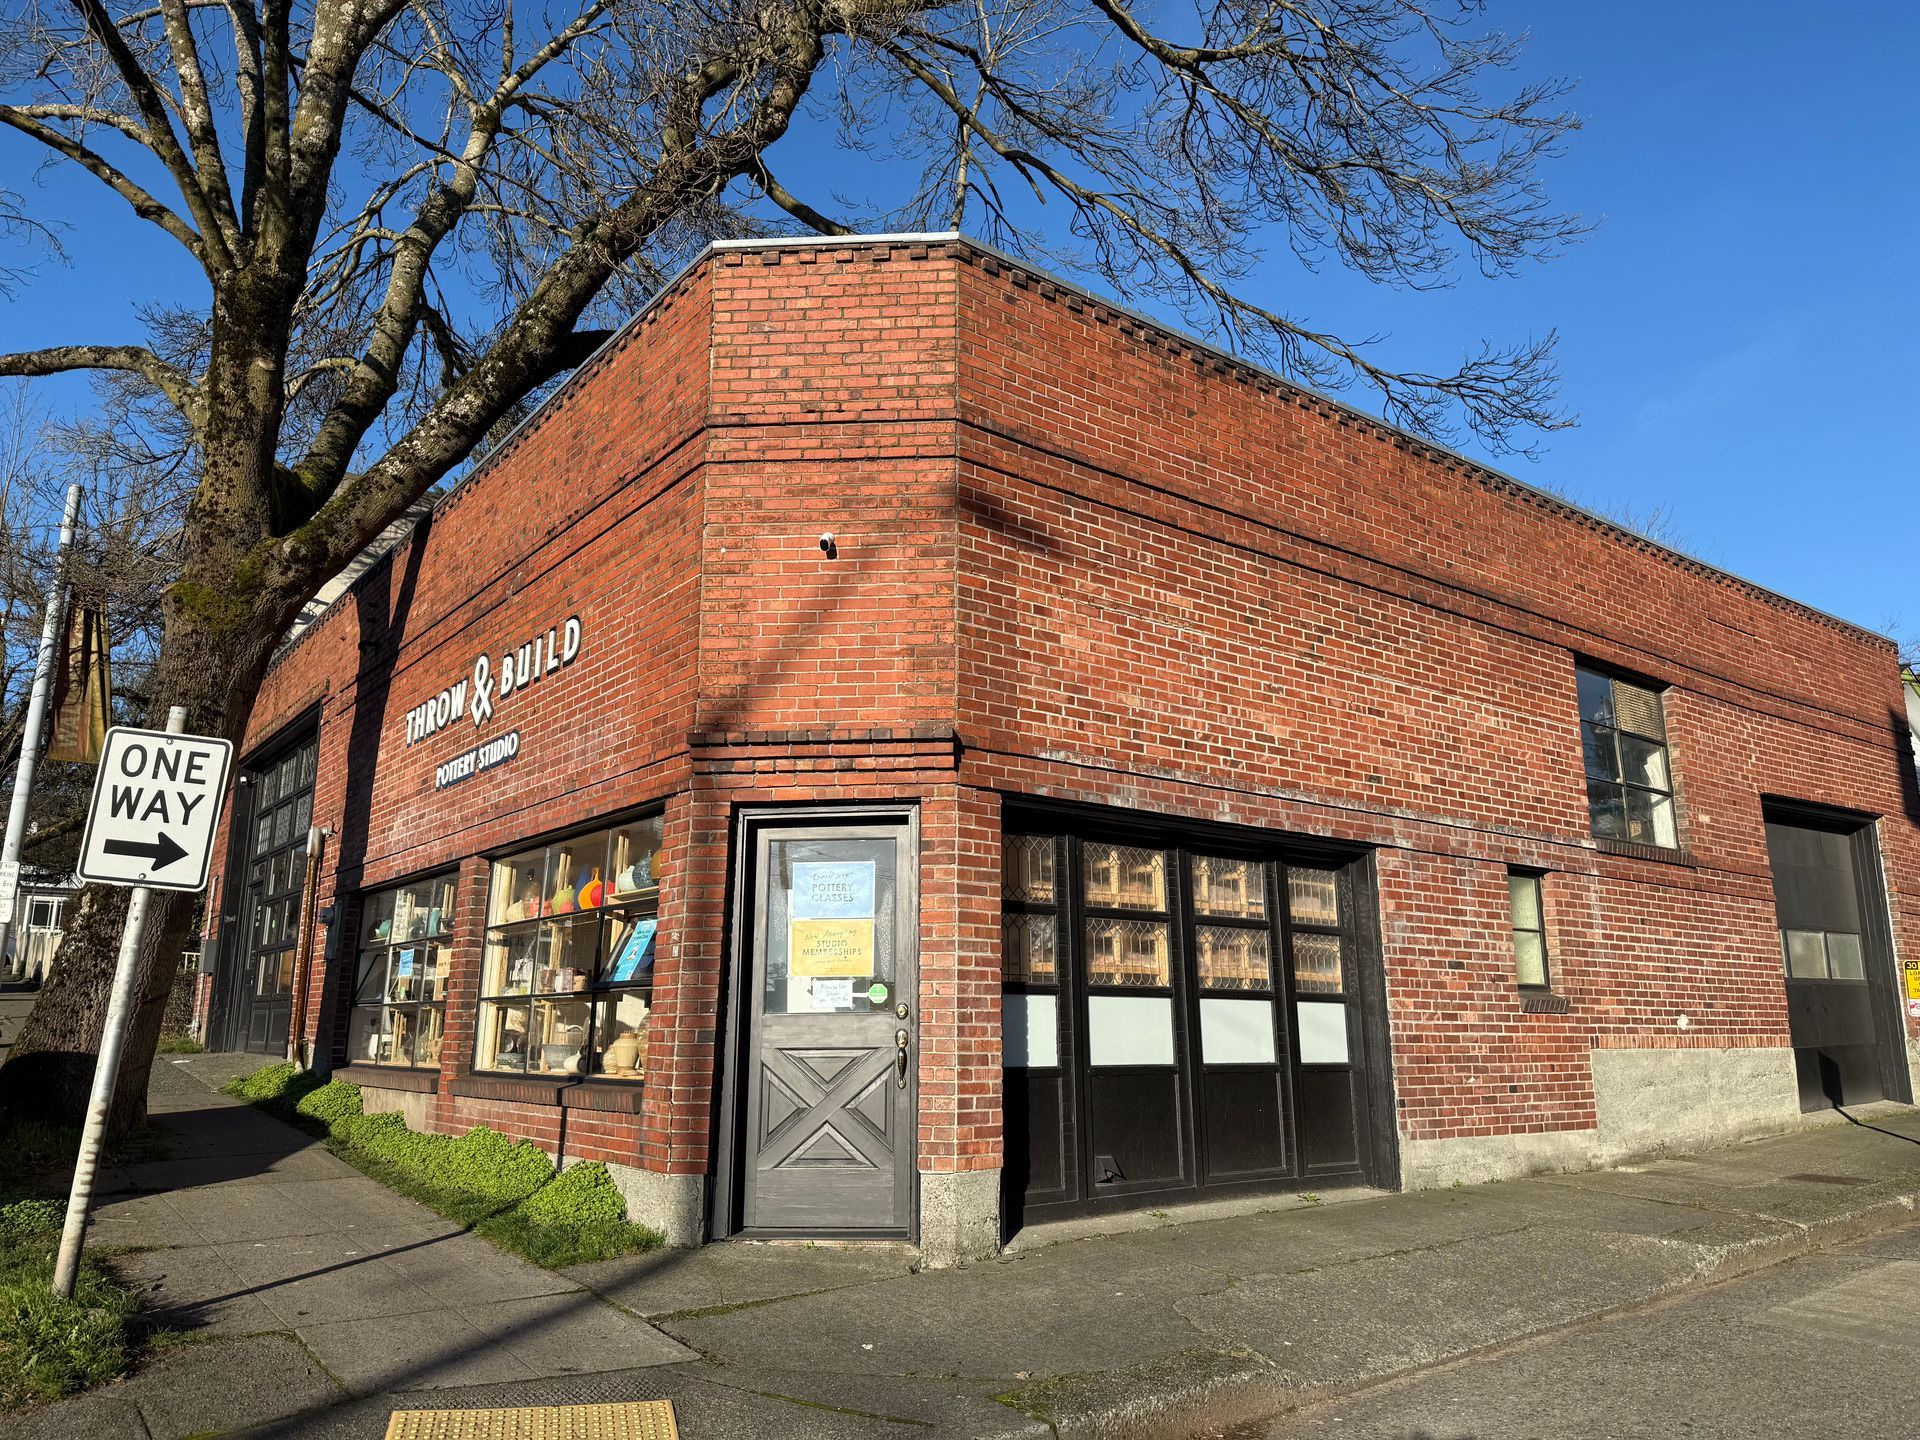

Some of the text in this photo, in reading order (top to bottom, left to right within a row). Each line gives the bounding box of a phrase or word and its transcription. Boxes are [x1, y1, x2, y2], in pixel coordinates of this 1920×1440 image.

[406, 614, 582, 748] THROW & BUILD
[120, 744, 211, 785] ONE
[435, 729, 520, 792] POTTERY STUDIO
[110, 784, 206, 826] WAY
[811, 893, 854, 902] CLASSES
[812, 883, 854, 892] POTTERY
[816, 939, 848, 948] STUDIO
